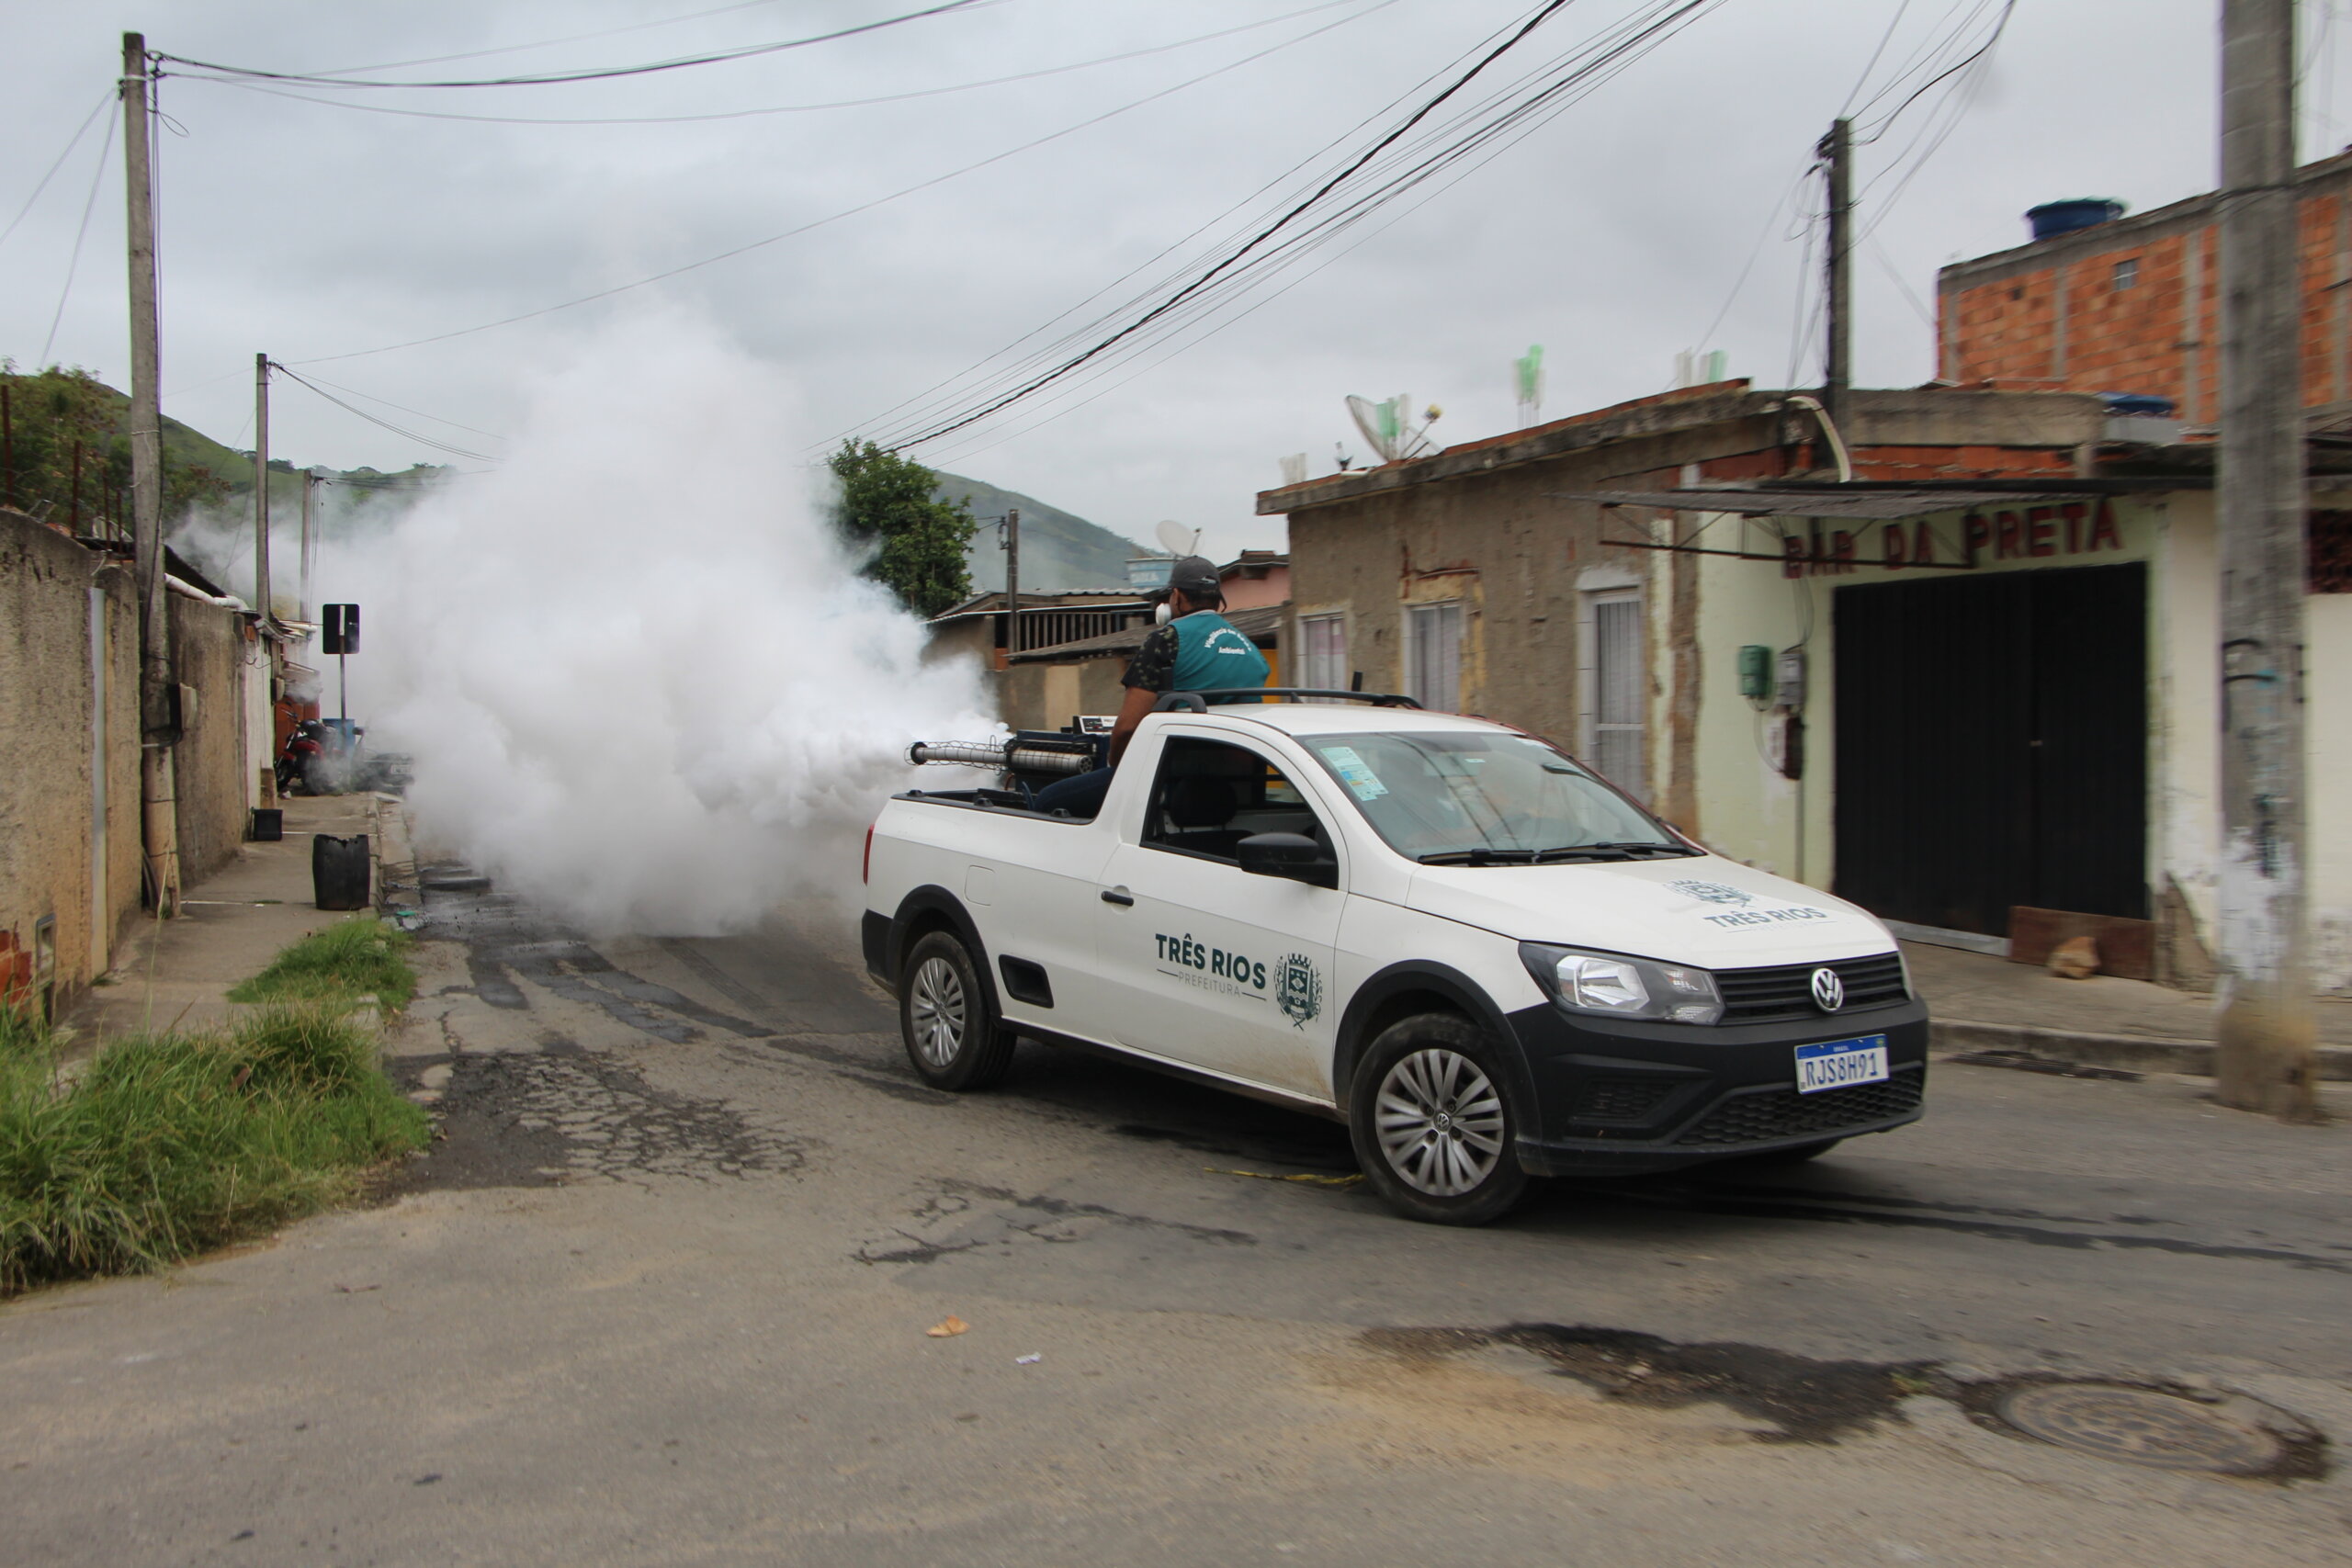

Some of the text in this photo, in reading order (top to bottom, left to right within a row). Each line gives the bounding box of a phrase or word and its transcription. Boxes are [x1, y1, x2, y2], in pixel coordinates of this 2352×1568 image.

[1782, 501, 2124, 579] BAR DA PRETA
[1703, 910, 1770, 928] TRÊS
[1764, 908, 1827, 921] RIOS
[1156, 932, 1266, 990] TRÊS RIOS
[1178, 971, 1240, 998] PREFEITURA
[1805, 1052, 1878, 1087] RJS8H91
